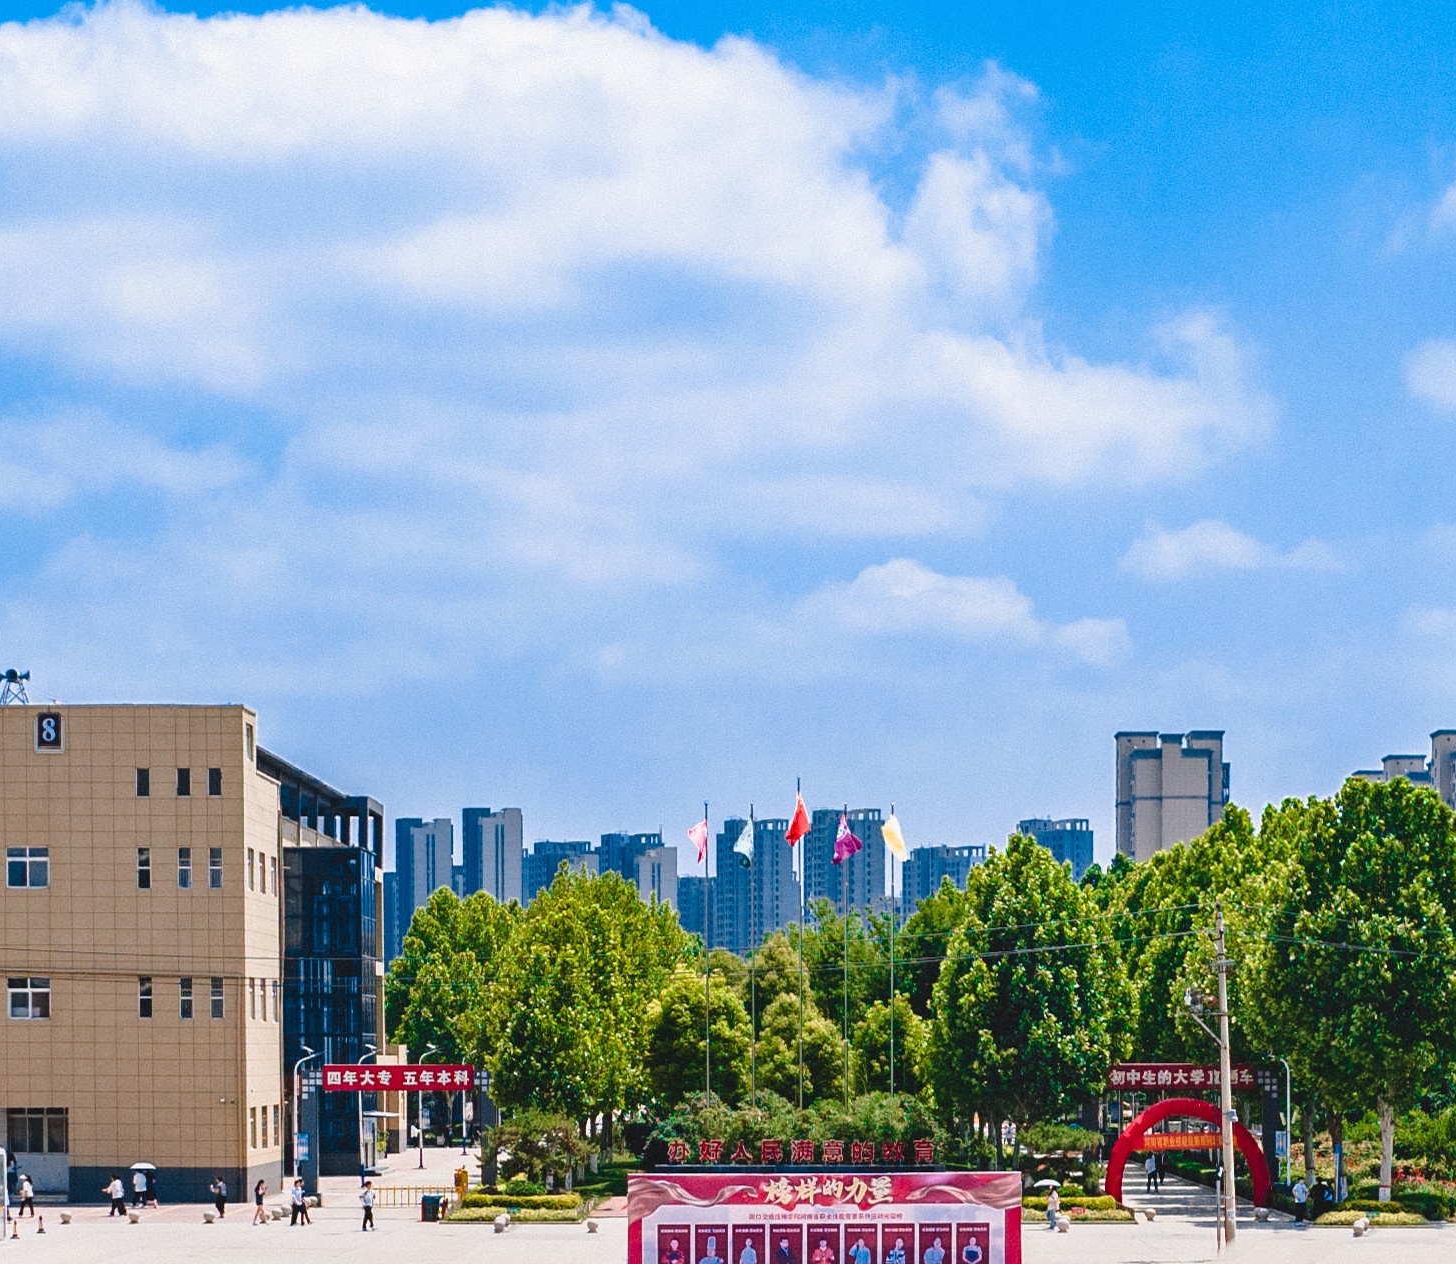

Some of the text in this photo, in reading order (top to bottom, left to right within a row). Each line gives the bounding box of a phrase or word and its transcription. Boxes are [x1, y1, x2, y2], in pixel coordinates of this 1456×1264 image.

[42, 717, 56, 742] 8
[326, 1069, 470, 1086] 四年大专 五年本科
[667, 1138, 936, 1163] 办好人民满意的教育
[762, 1176, 894, 1206] 榜样的力量
